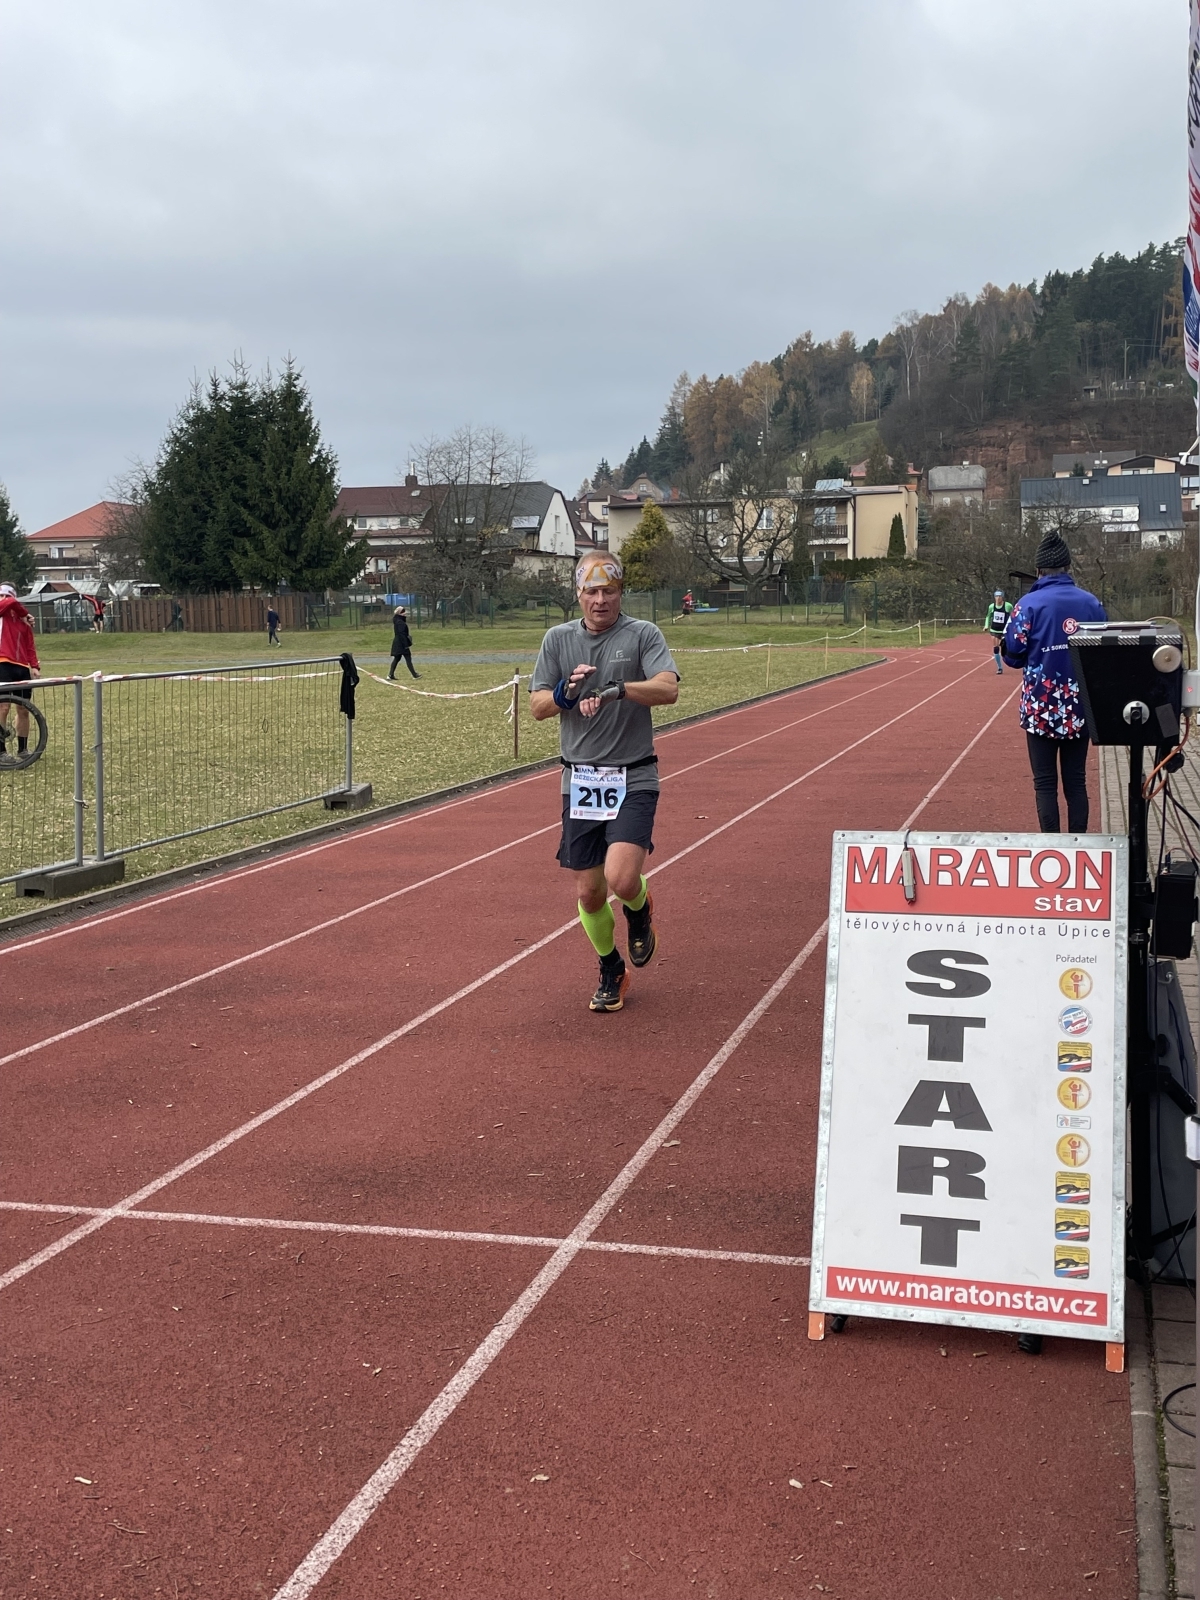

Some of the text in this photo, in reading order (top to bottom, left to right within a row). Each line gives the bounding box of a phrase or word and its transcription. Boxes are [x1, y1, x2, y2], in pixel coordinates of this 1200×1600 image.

[578, 786, 618, 809] 216
[846, 846, 1112, 890] MARATON
[1034, 894, 1103, 913] stav
[846, 917, 1111, 939] tělovýchovná jednota Úpice
[1055, 953, 1098, 964] Pořadatel
[894, 949, 993, 1268] START
[836, 1274, 1097, 1318] www.maratonstav.cz
